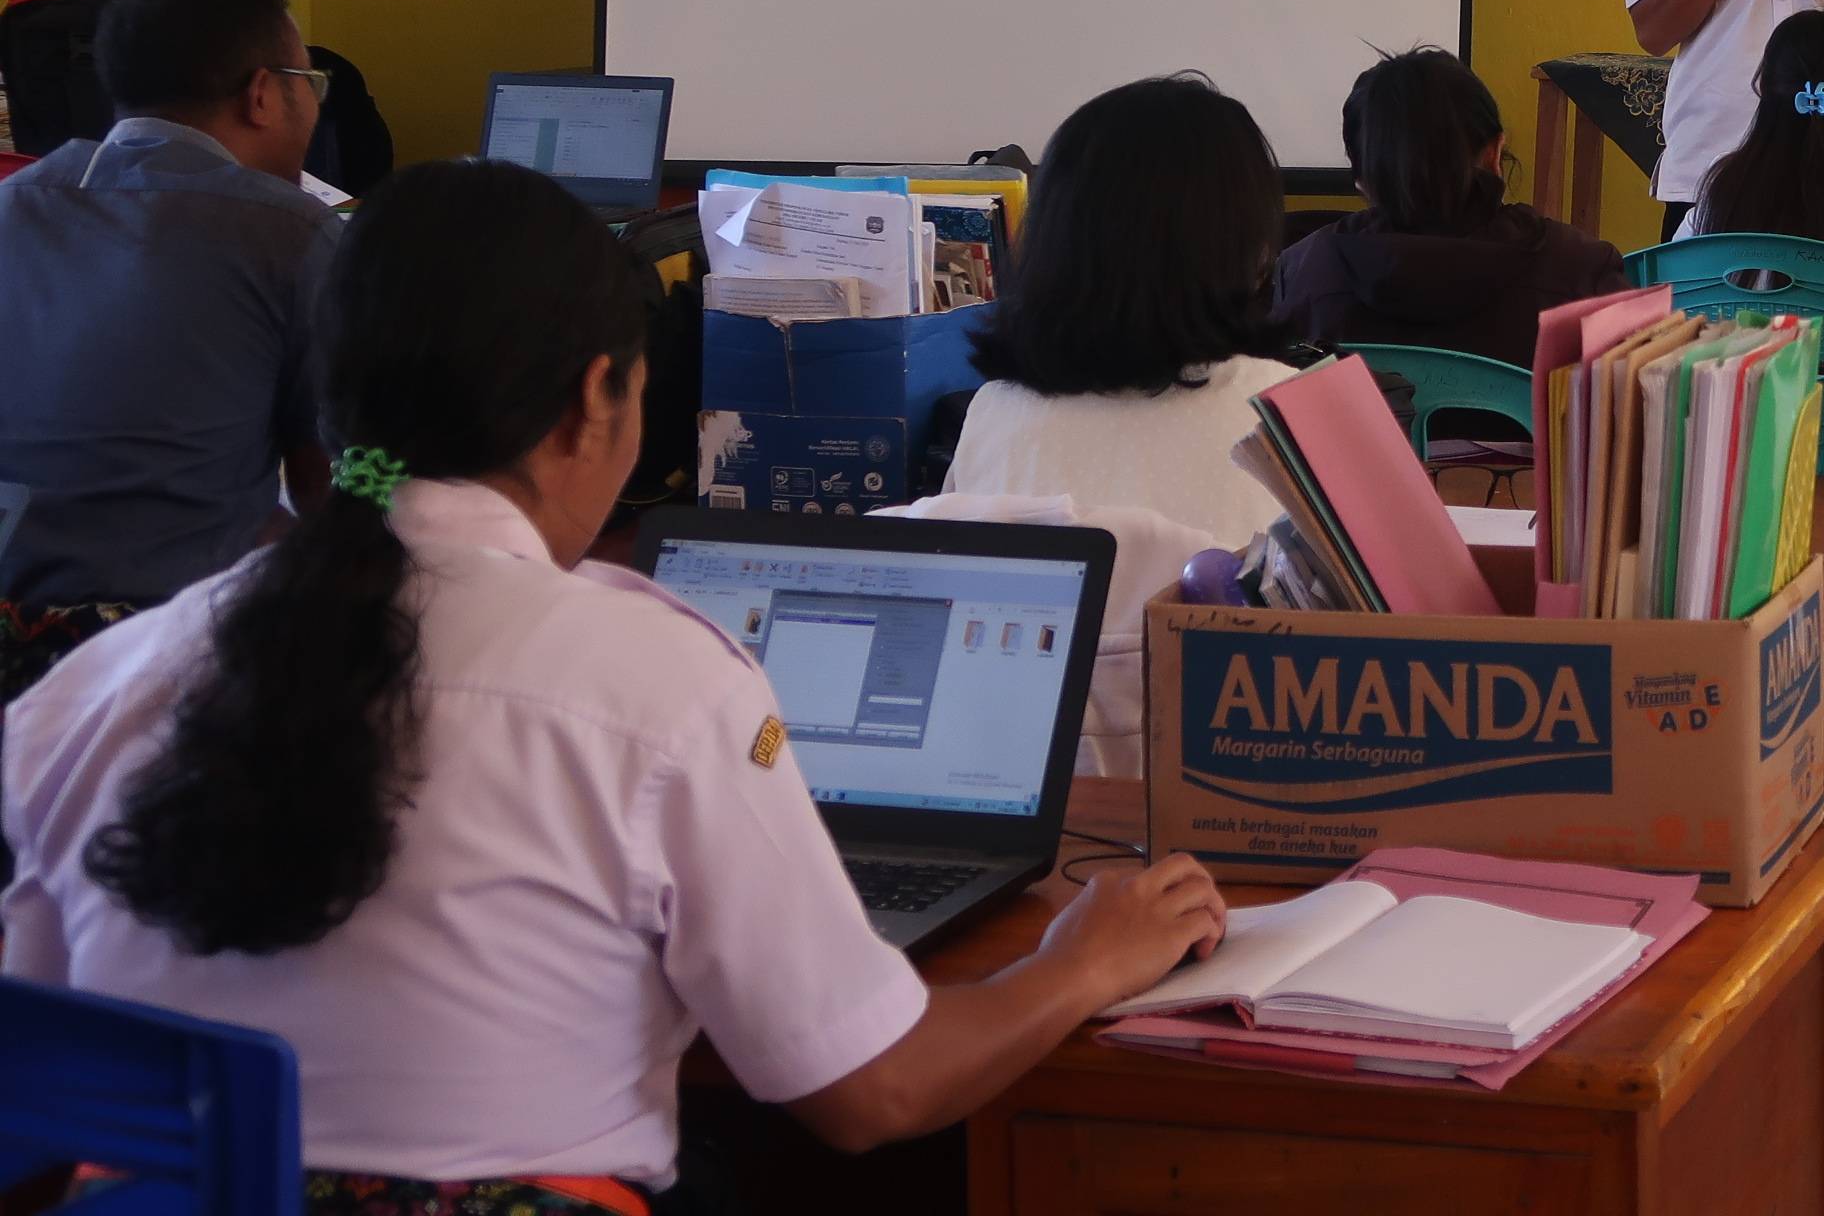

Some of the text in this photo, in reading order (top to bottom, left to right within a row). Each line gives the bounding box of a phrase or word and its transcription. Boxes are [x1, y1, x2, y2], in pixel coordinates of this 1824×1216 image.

[1209, 652, 1601, 745] AMANDA
[1704, 684, 1721, 706] E
[1659, 709, 1708, 732] A D
[1211, 735, 1425, 766] Margarin Serbaguna
[1192, 818, 1378, 839] untuk berbagai masakan
